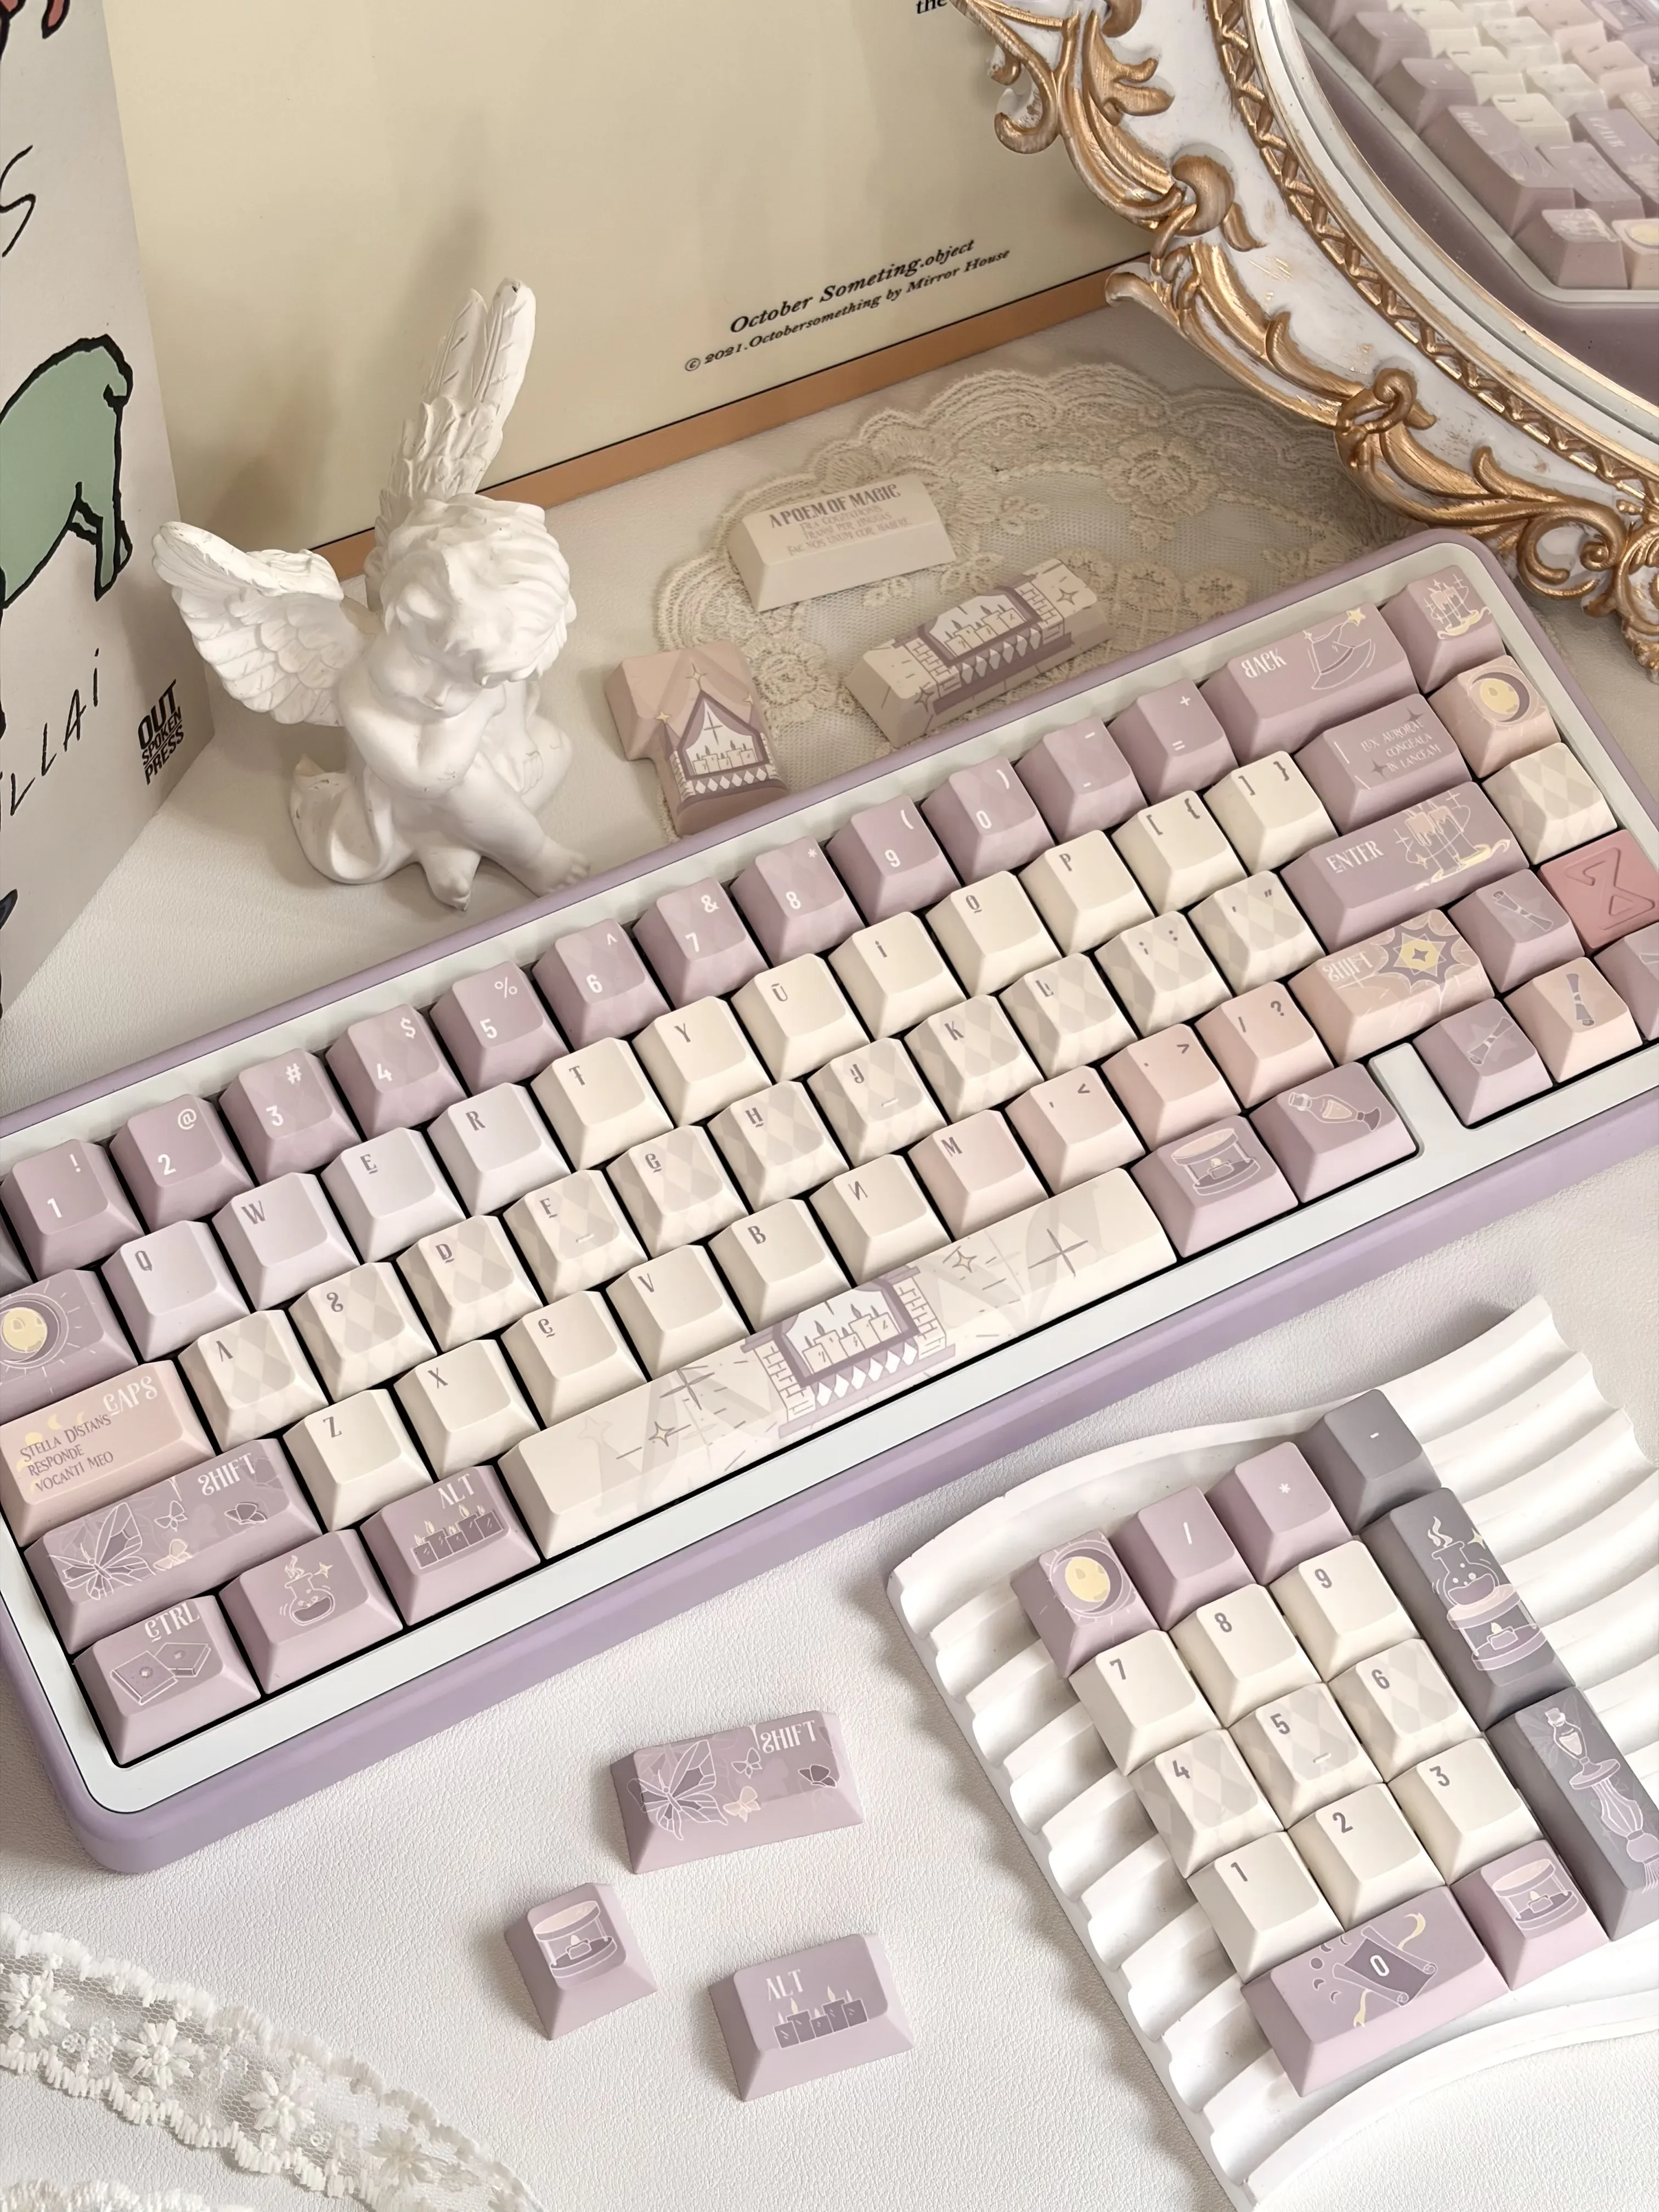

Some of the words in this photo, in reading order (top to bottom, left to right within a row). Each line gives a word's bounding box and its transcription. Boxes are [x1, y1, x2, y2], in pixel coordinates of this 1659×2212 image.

[886, 289, 902, 301] by
[906, 267, 960, 293] Mirror
[963, 250, 1010, 273] House
[730, 297, 814, 332] October
[769, 514, 782, 528] A
[780, 502, 828, 524] POEM
[827, 496, 847, 514] OF
[849, 483, 901, 507] MAGIC
[1241, 648, 1287, 678] BACK
[1180, 696, 1190, 706] +
[138, 679, 176, 749] OUT
[142, 706, 182, 766] SPOKEN
[145, 724, 184, 786] PRESS
[996, 769, 1010, 789] )
[900, 809, 914, 830] (
[975, 810, 992, 830] 0
[884, 849, 901, 867] 9
[1059, 853, 1073, 872] P
[1325, 840, 1384, 873] ENTER
[701, 895, 719, 913] &
[786, 891, 802, 910] 8
[685, 932, 699, 952] 7
[494, 977, 518, 998] %
[586, 974, 602, 993] 6
[1270, 1001, 1285, 1017] ?
[400, 1017, 416, 1039] $
[479, 1018, 498, 1039] 5
[674, 1023, 691, 1043] Y
[944, 1021, 964, 1041] K
[1177, 1043, 1190, 1054] >
[286, 1063, 302, 1084] #
[377, 1063, 393, 1081] 4
[568, 1065, 585, 1086] T
[1077, 1083, 1091, 1094] <
[177, 1108, 197, 1130] @
[266, 1105, 284, 1126] 3
[466, 1110, 486, 1131] R
[744, 1107, 764, 1128] H
[941, 1137, 963, 1158] M
[70, 1154, 81, 1172] !
[157, 1154, 176, 1176] 2
[360, 1154, 378, 1175] E
[47, 1198, 62, 1218] 1
[241, 1200, 266, 1225] W
[539, 1198, 558, 1218] F
[747, 1226, 766, 1245] B
[134, 1250, 153, 1272] Q
[435, 1243, 455, 1263] D
[637, 1273, 654, 1294] V
[427, 1367, 448, 1389] X
[103, 1376, 157, 1416] CAPS
[323, 1416, 342, 1438] Z
[20, 1436, 62, 1462] STELLA
[64, 1414, 111, 1443] DISTANS
[27, 1444, 84, 1476] RESPONDE
[35, 1462, 84, 1492] VOCANTI
[87, 1451, 114, 1469] MEO
[198, 1453, 256, 1496] SHIFT
[438, 1473, 474, 1509] ALT
[1314, 1568, 1333, 1589] 9
[145, 1601, 201, 1643] CTRL
[1214, 1612, 1232, 1633] 8
[1109, 1658, 1126, 1680] 7
[1371, 1669, 1390, 1690] 6
[1270, 1713, 1290, 1735] 5
[760, 1720, 816, 1753] SHIFT
[1173, 1759, 1190, 1779] 4
[1429, 1765, 1450, 1787] 3
[1332, 1812, 1353, 1833] 2
[1231, 1861, 1248, 1882] 1
[1370, 1955, 1390, 1977] 0
[766, 1968, 803, 2001] ALT
